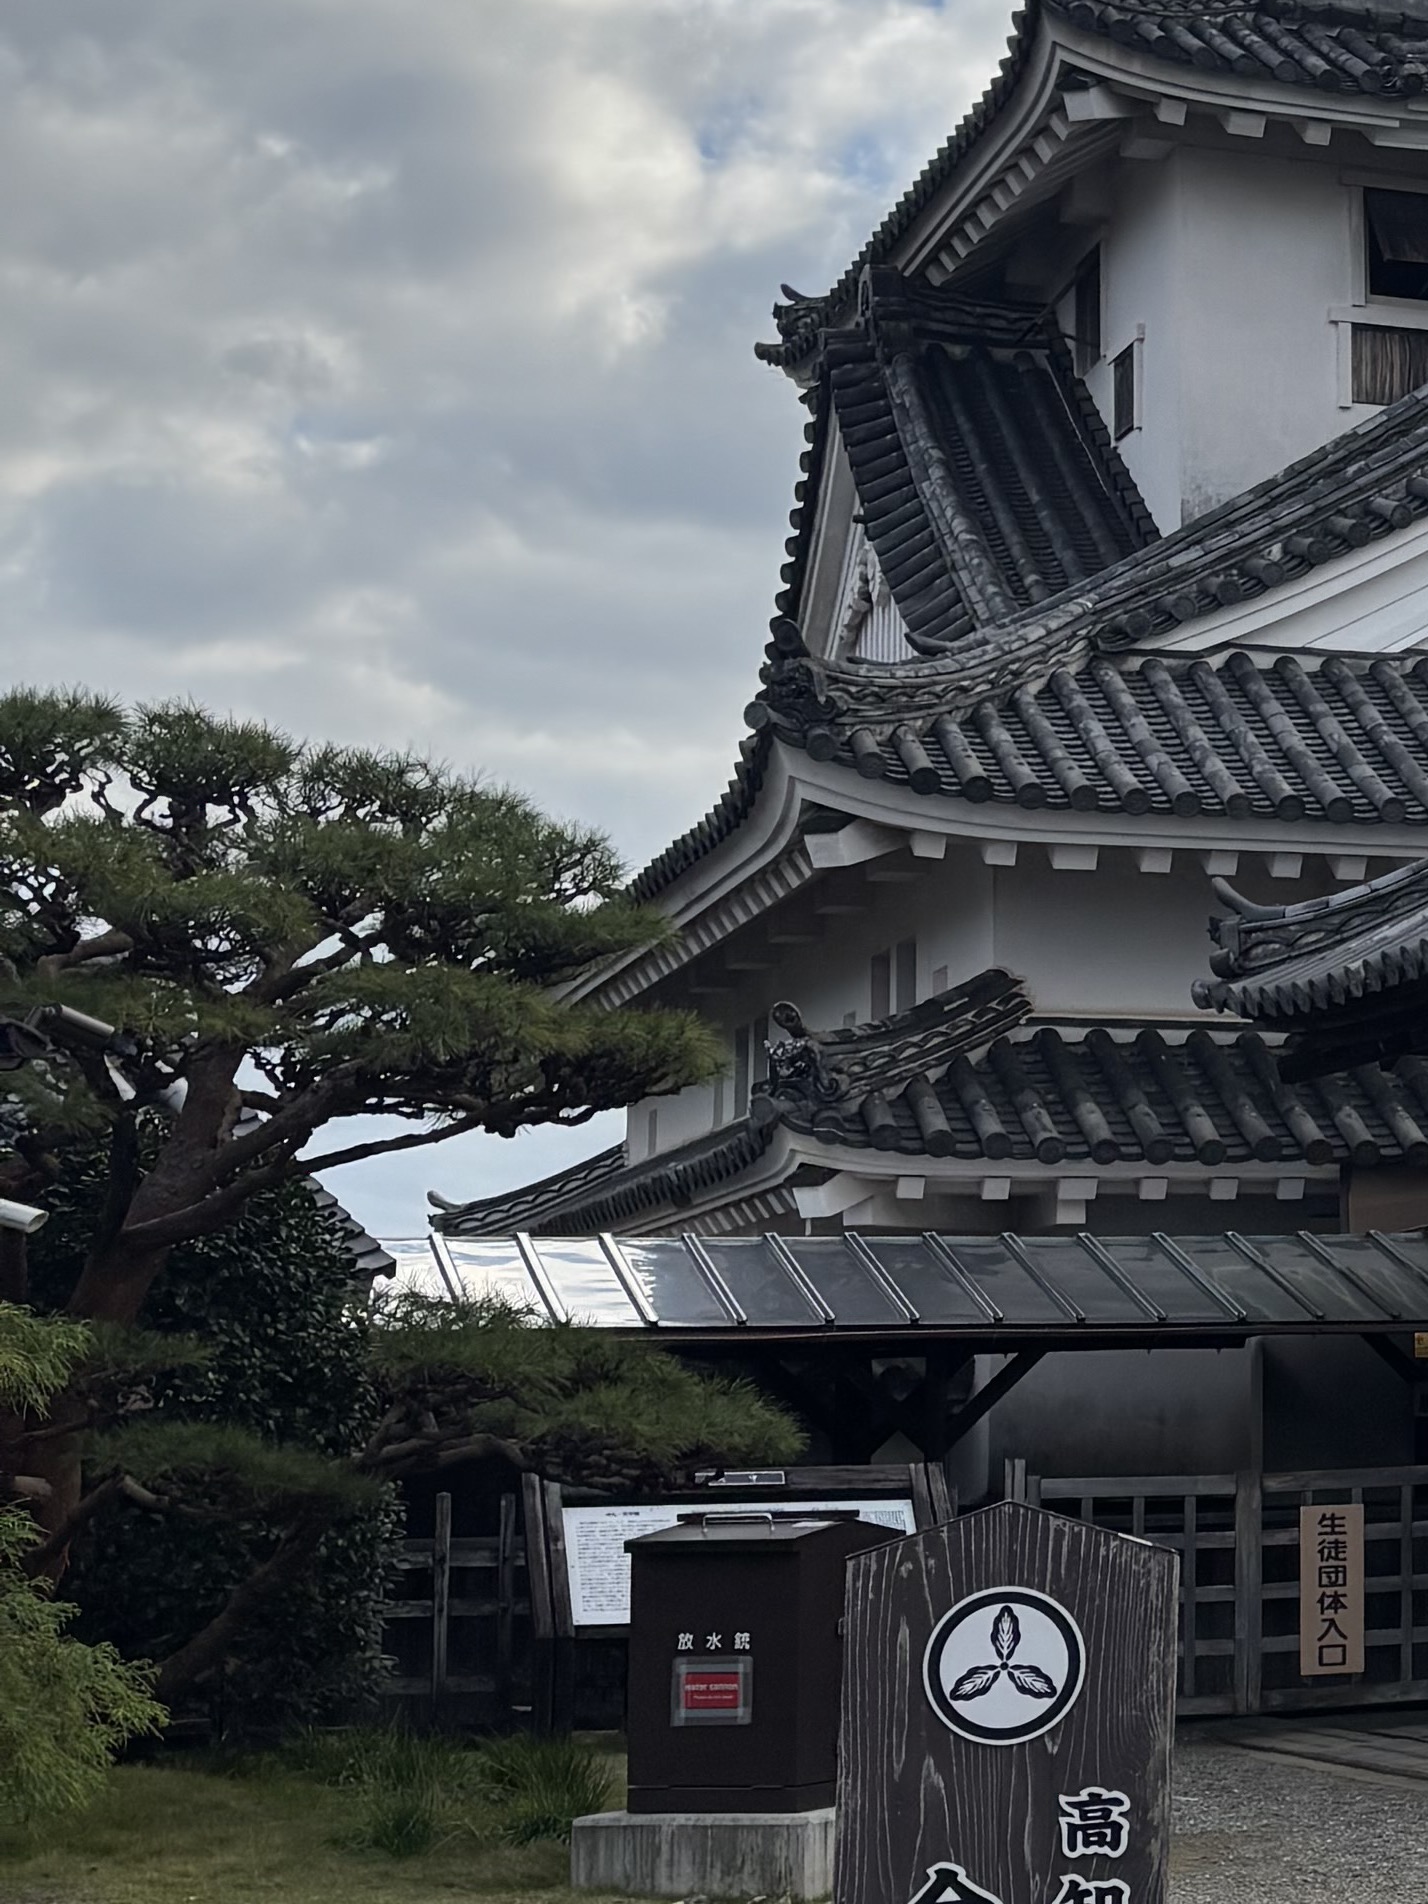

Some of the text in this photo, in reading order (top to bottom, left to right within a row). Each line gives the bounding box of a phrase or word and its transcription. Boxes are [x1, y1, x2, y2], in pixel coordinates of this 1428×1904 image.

[1316, 1512, 1348, 1667] 生徒団体入口
[677, 1632, 750, 1650] 放水銃
